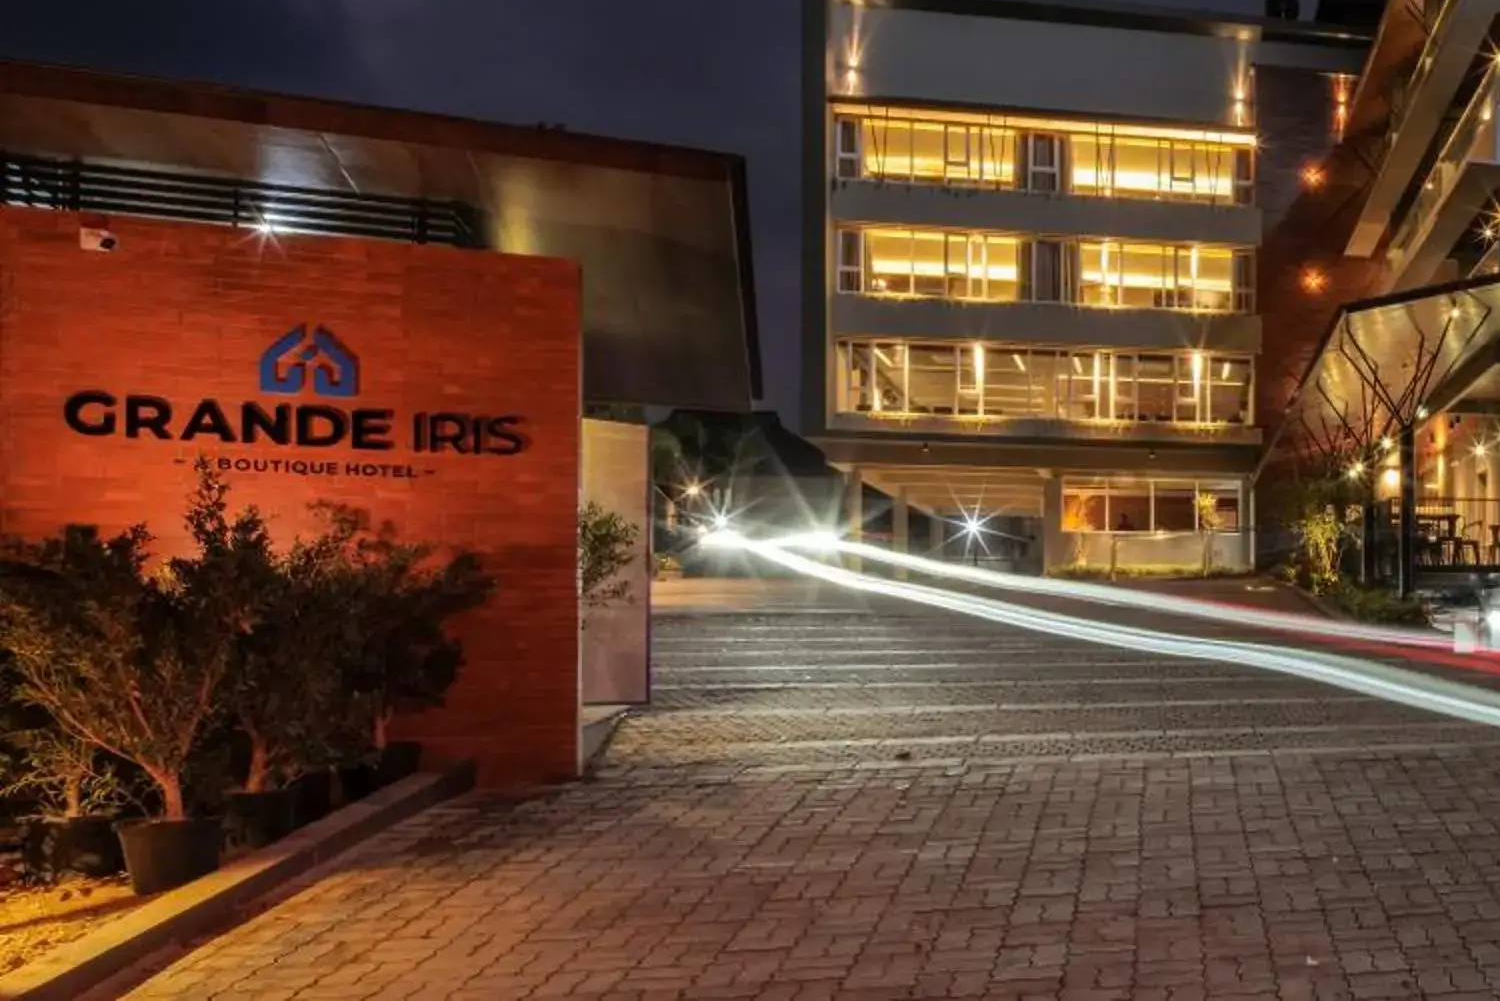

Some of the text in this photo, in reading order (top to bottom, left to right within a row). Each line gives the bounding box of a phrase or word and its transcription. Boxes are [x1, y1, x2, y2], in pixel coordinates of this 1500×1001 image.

[64, 390, 528, 456] GRANDE IRIS
[217, 457, 339, 476] BOUTIQUE
[345, 463, 418, 479] HOTEL
